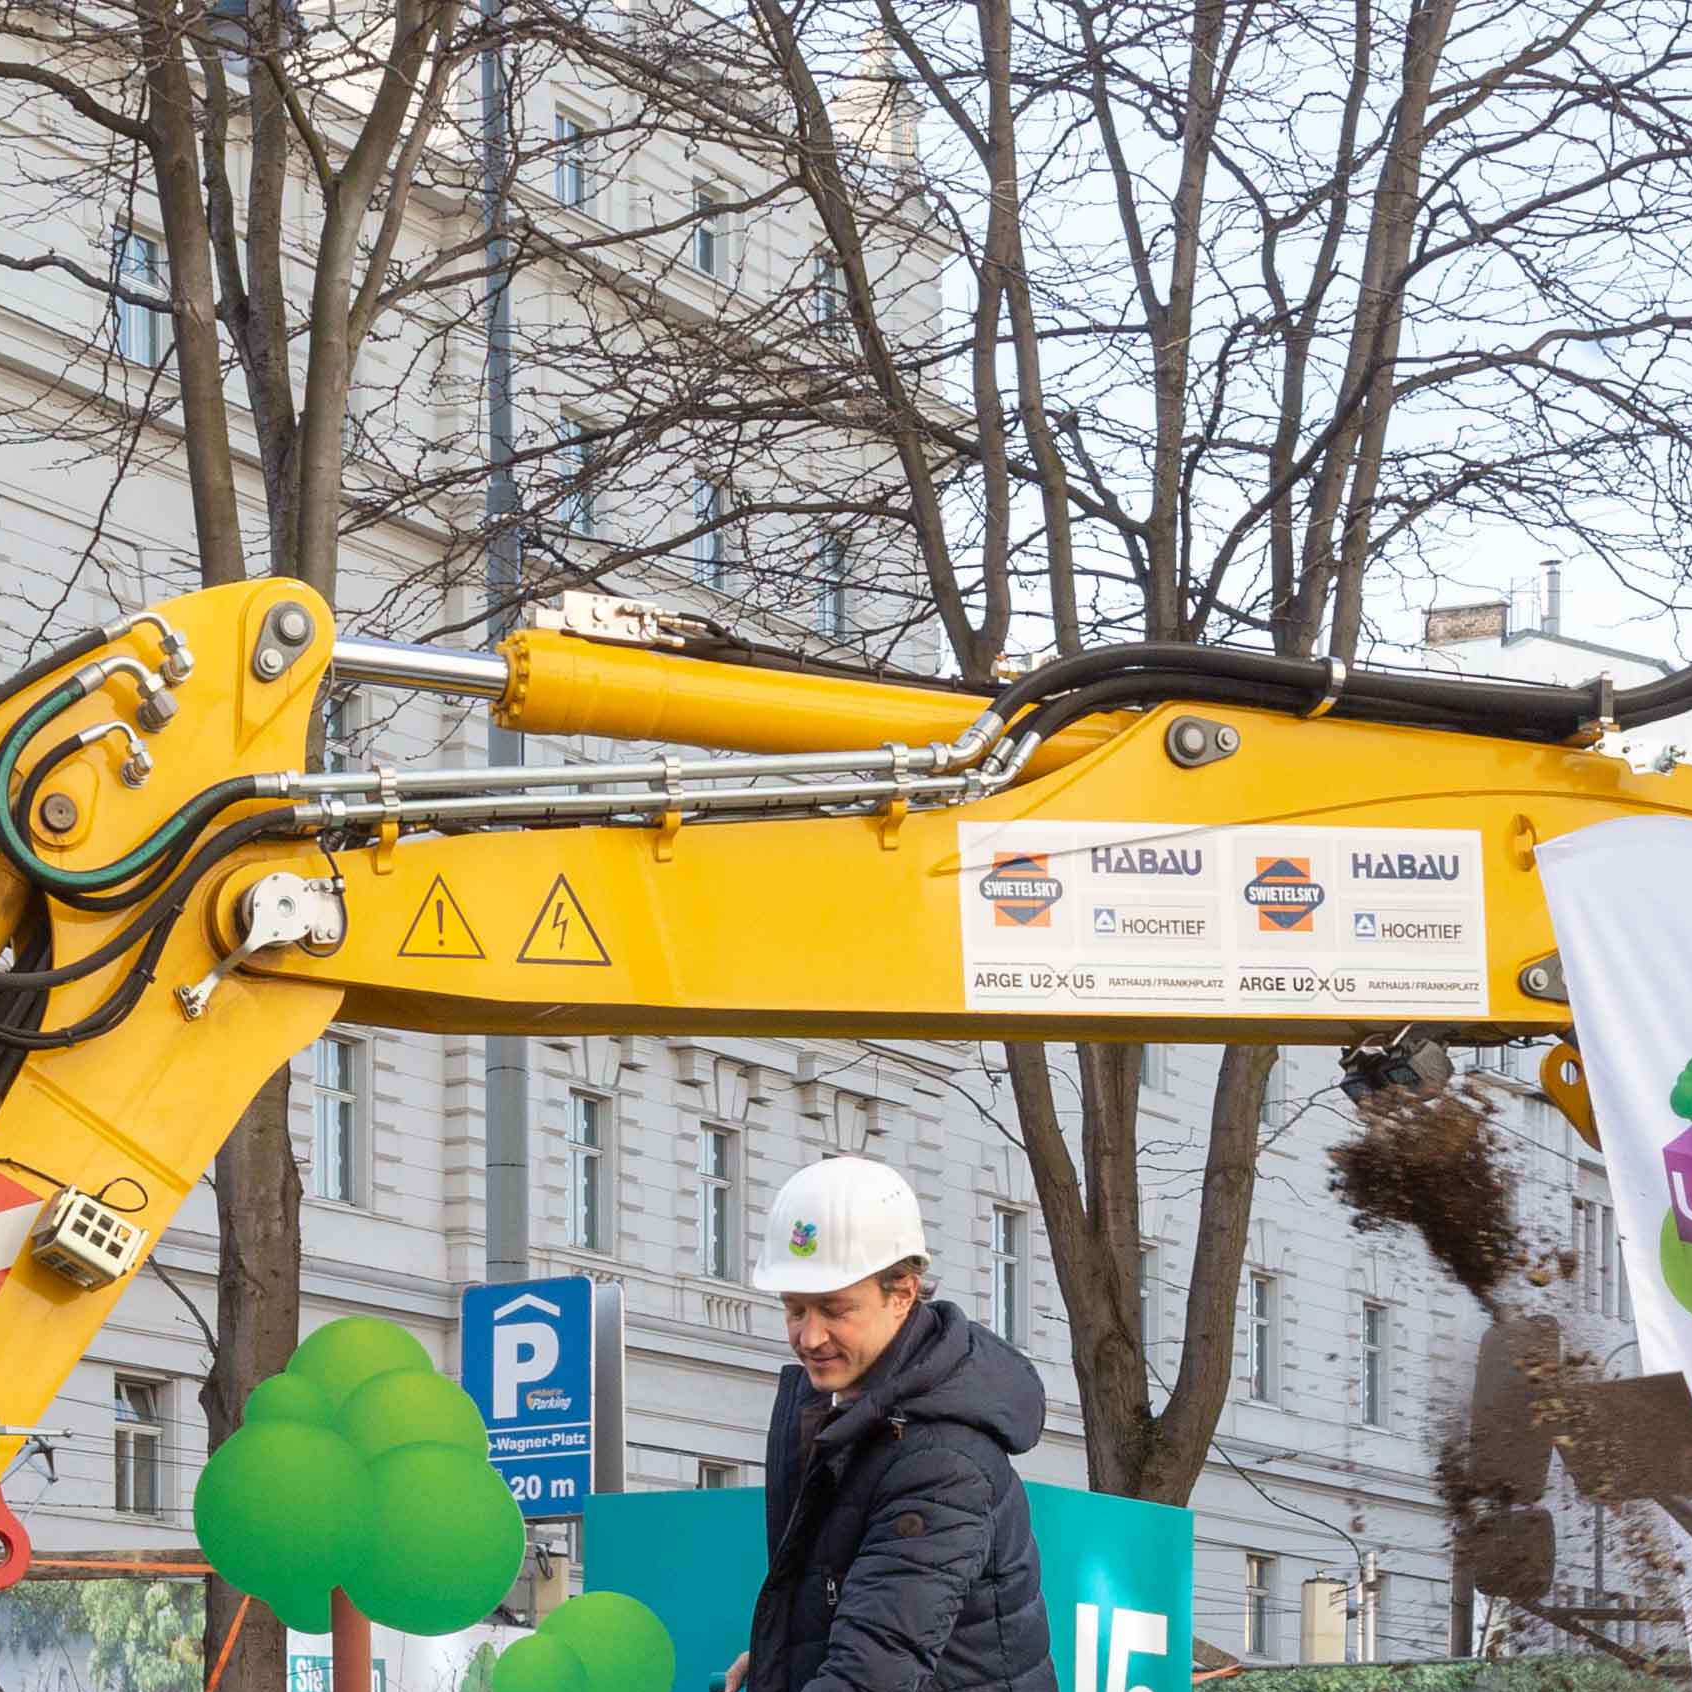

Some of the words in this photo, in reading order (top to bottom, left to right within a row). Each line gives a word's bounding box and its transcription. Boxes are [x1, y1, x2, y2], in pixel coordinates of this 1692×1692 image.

[1091, 847, 1203, 876] HABAU
[1351, 852, 1460, 881] HABAU
[984, 880, 1059, 898] SWIETELSKY
[1249, 885, 1321, 903] SWIETELSKY
[1121, 919, 1205, 936] HOCHTIEF
[1381, 923, 1462, 940] HOCHTIEF
[974, 973, 1023, 989] ARGE
[1239, 976, 1286, 992] ARGE
[492, 1322, 560, 1420] P
[550, 1477, 575, 1499] m
